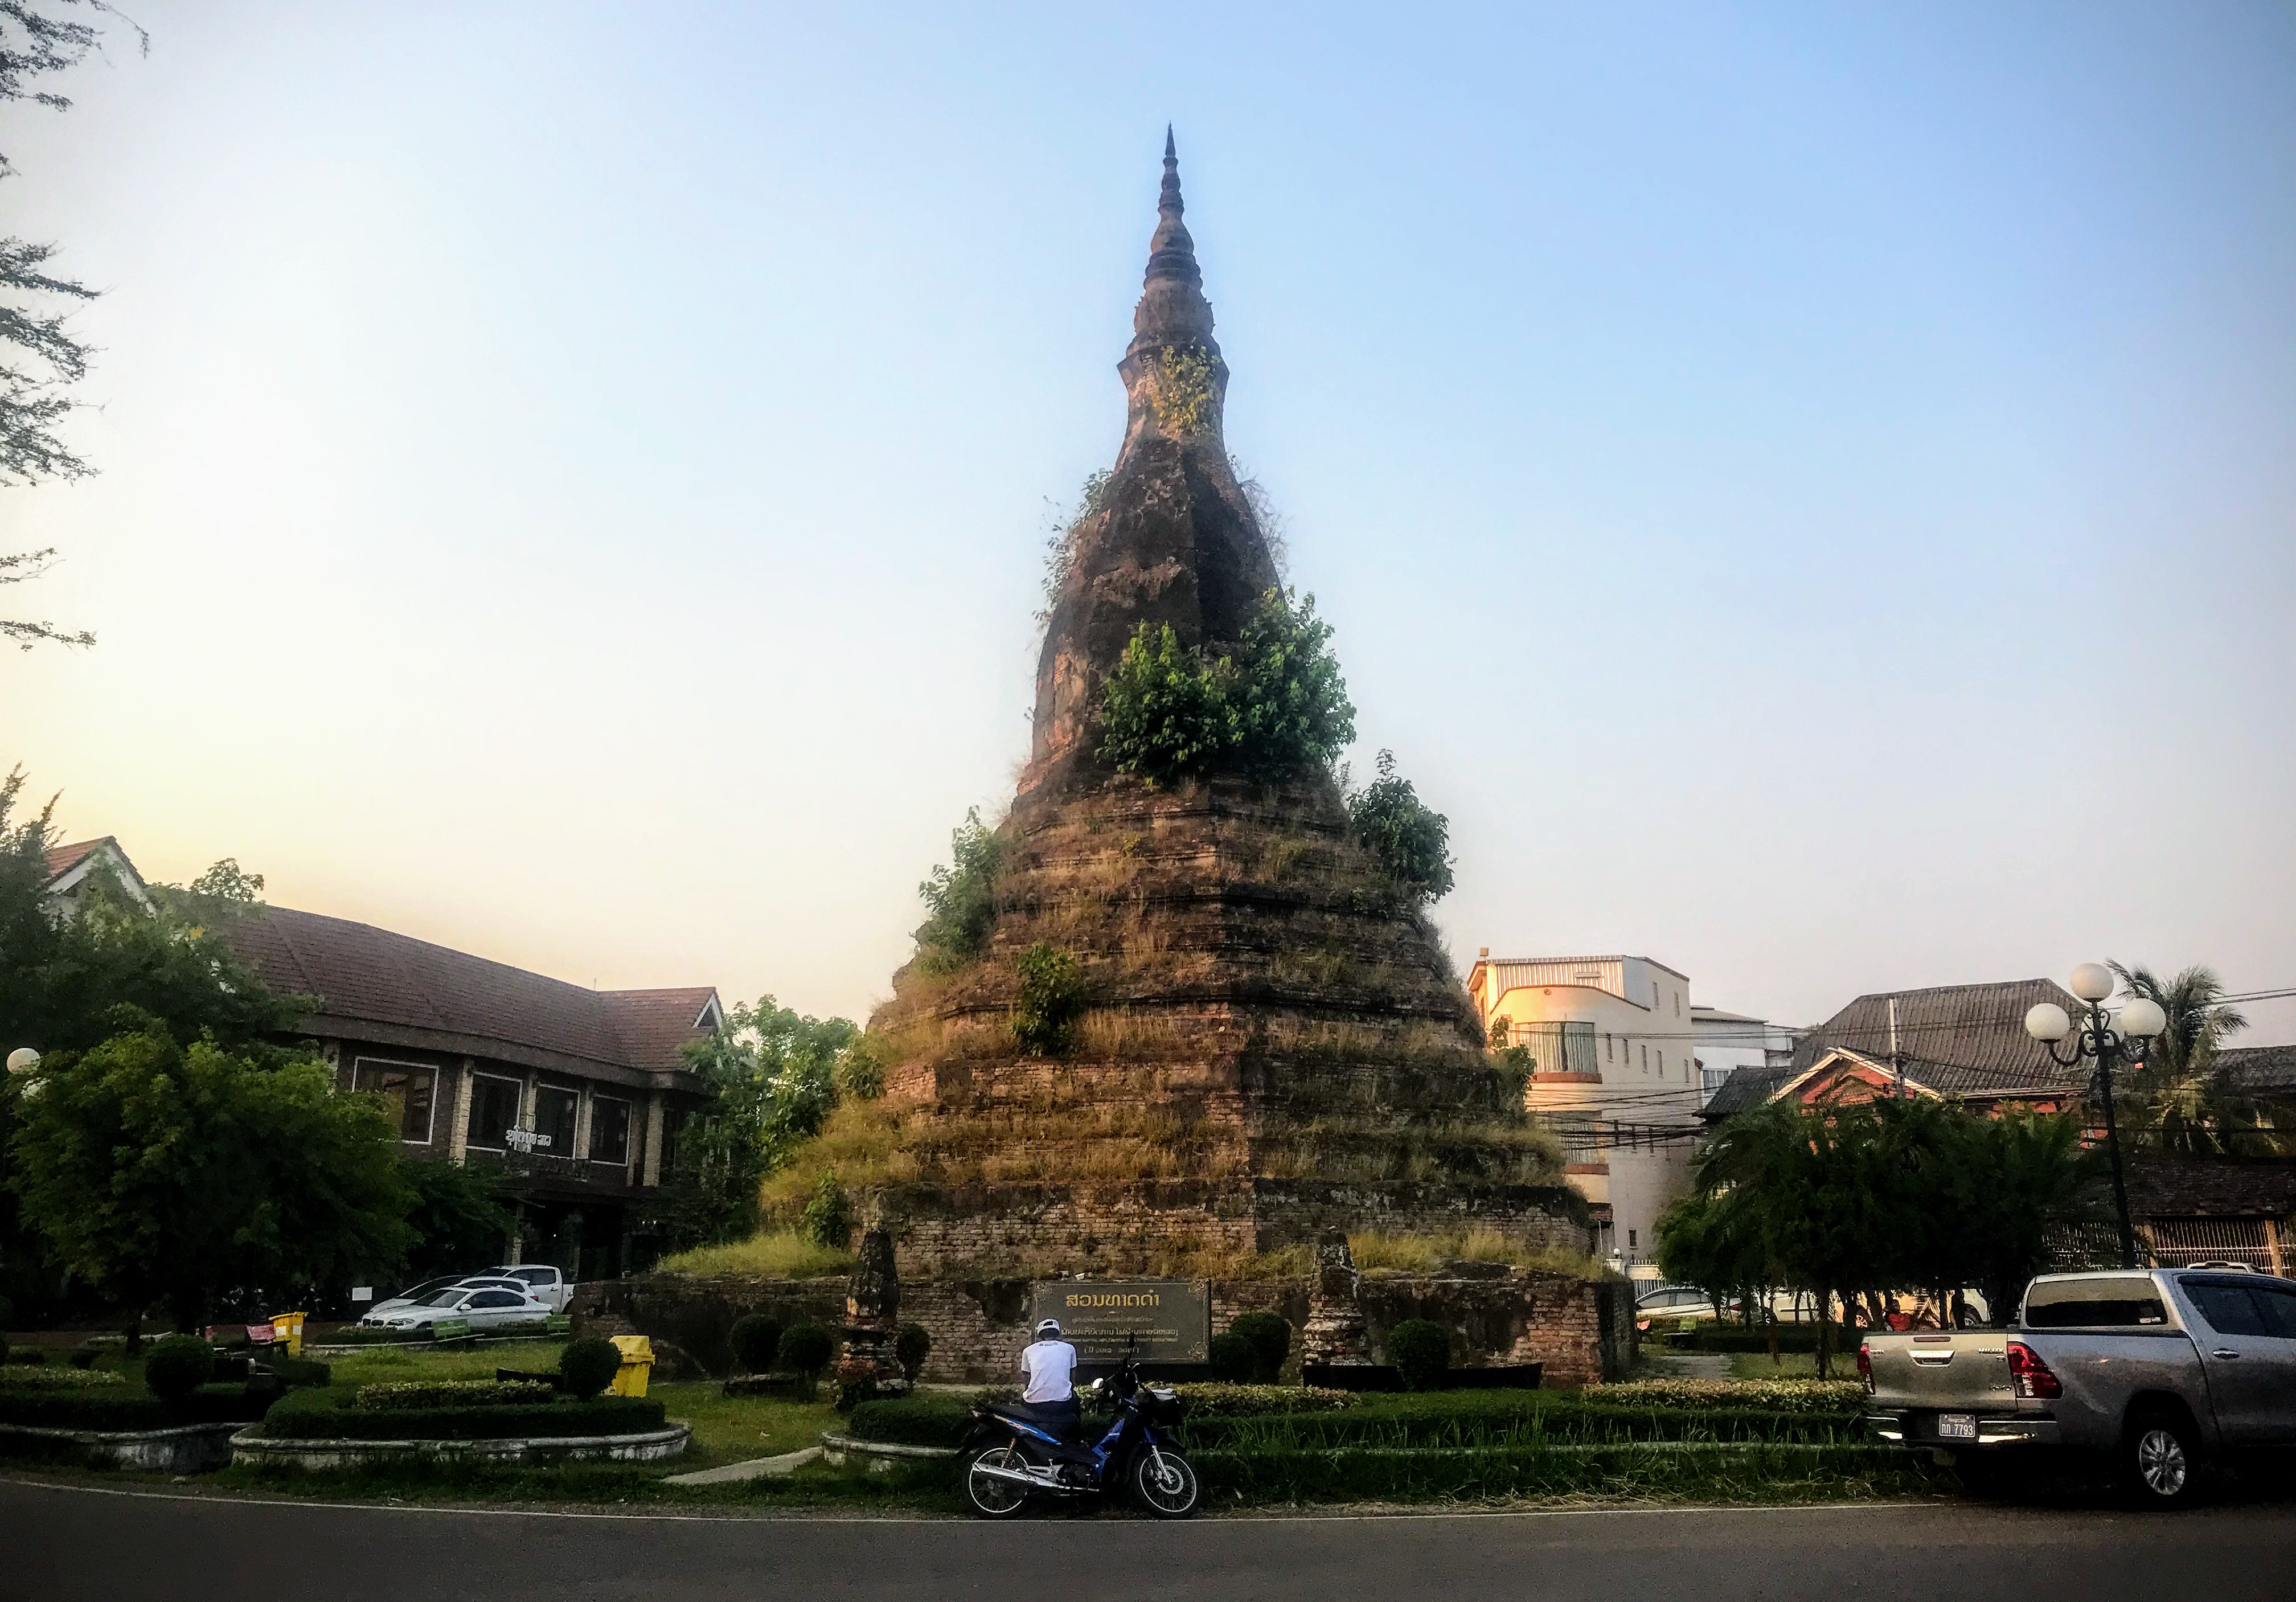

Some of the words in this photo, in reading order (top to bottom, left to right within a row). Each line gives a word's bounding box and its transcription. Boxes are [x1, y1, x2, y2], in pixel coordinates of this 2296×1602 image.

[1066, 1289, 1159, 1306] ສວນທາດດຳ
[1954, 1424, 1973, 1436] 7793
